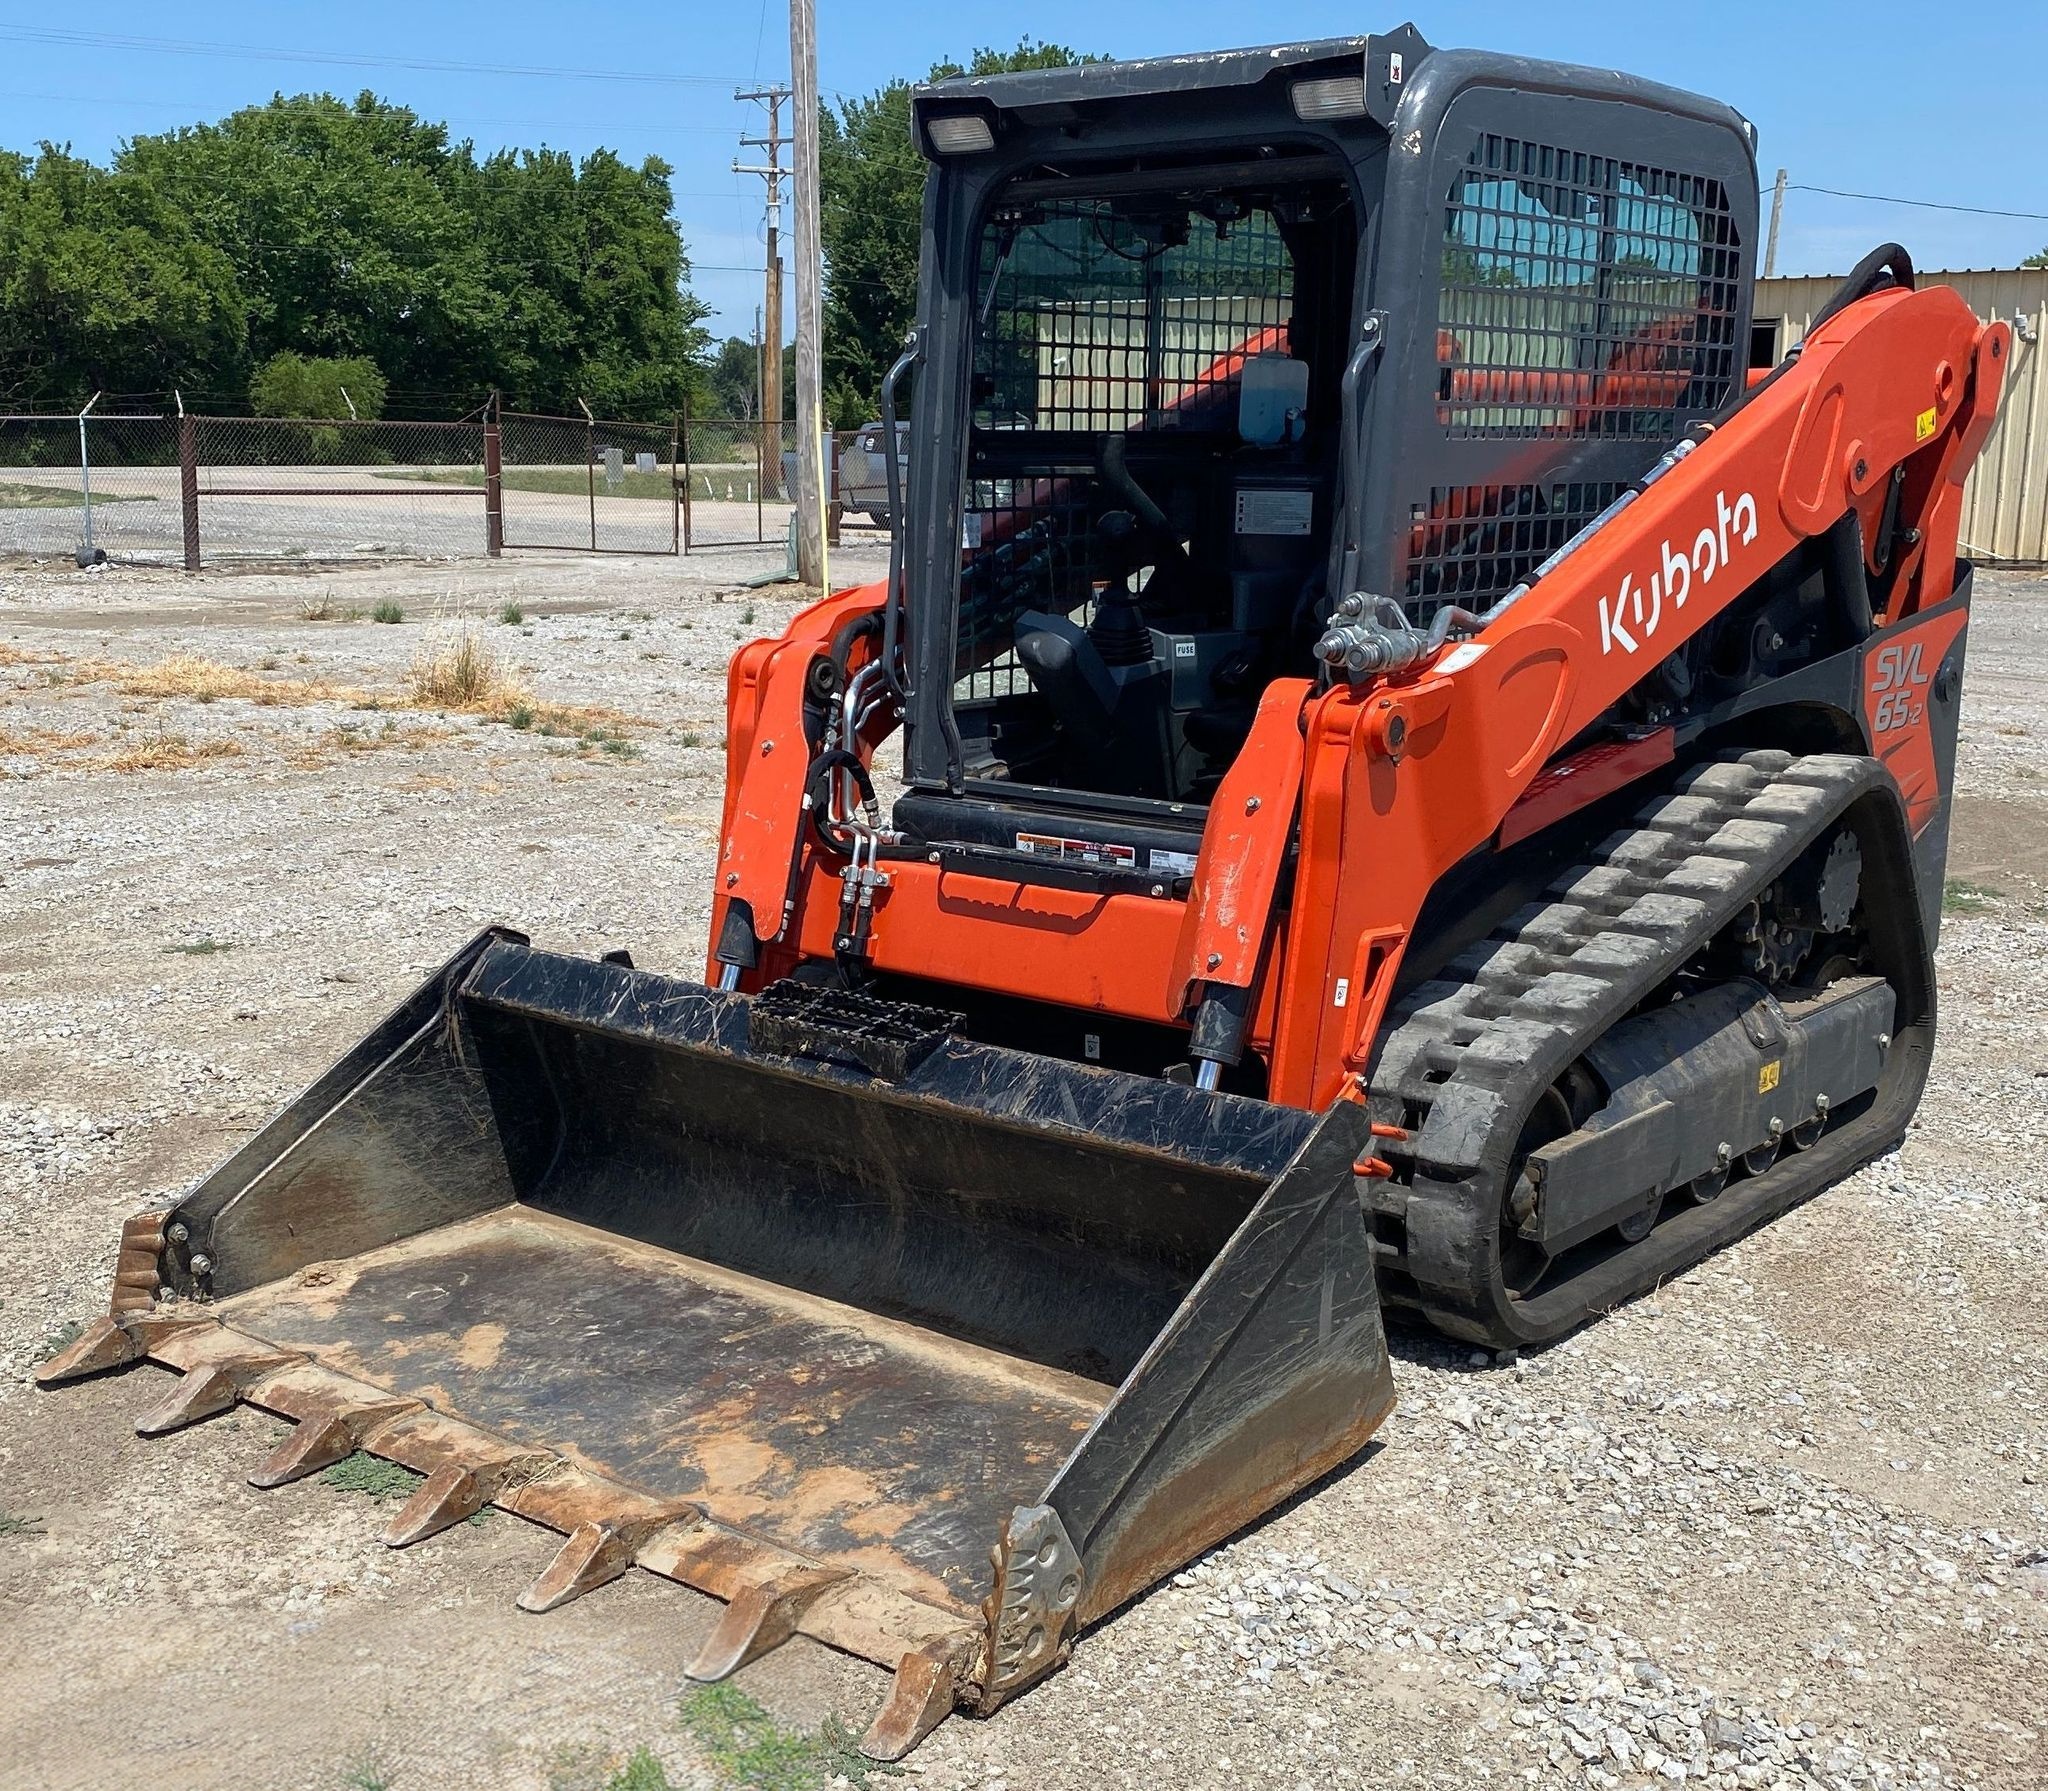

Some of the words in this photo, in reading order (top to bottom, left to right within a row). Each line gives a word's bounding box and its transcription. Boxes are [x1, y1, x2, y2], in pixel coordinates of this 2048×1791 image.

[1598, 490, 1758, 655] Kubota
[1177, 646, 1194, 655] FUSE
[1871, 642, 1929, 692] SVL
